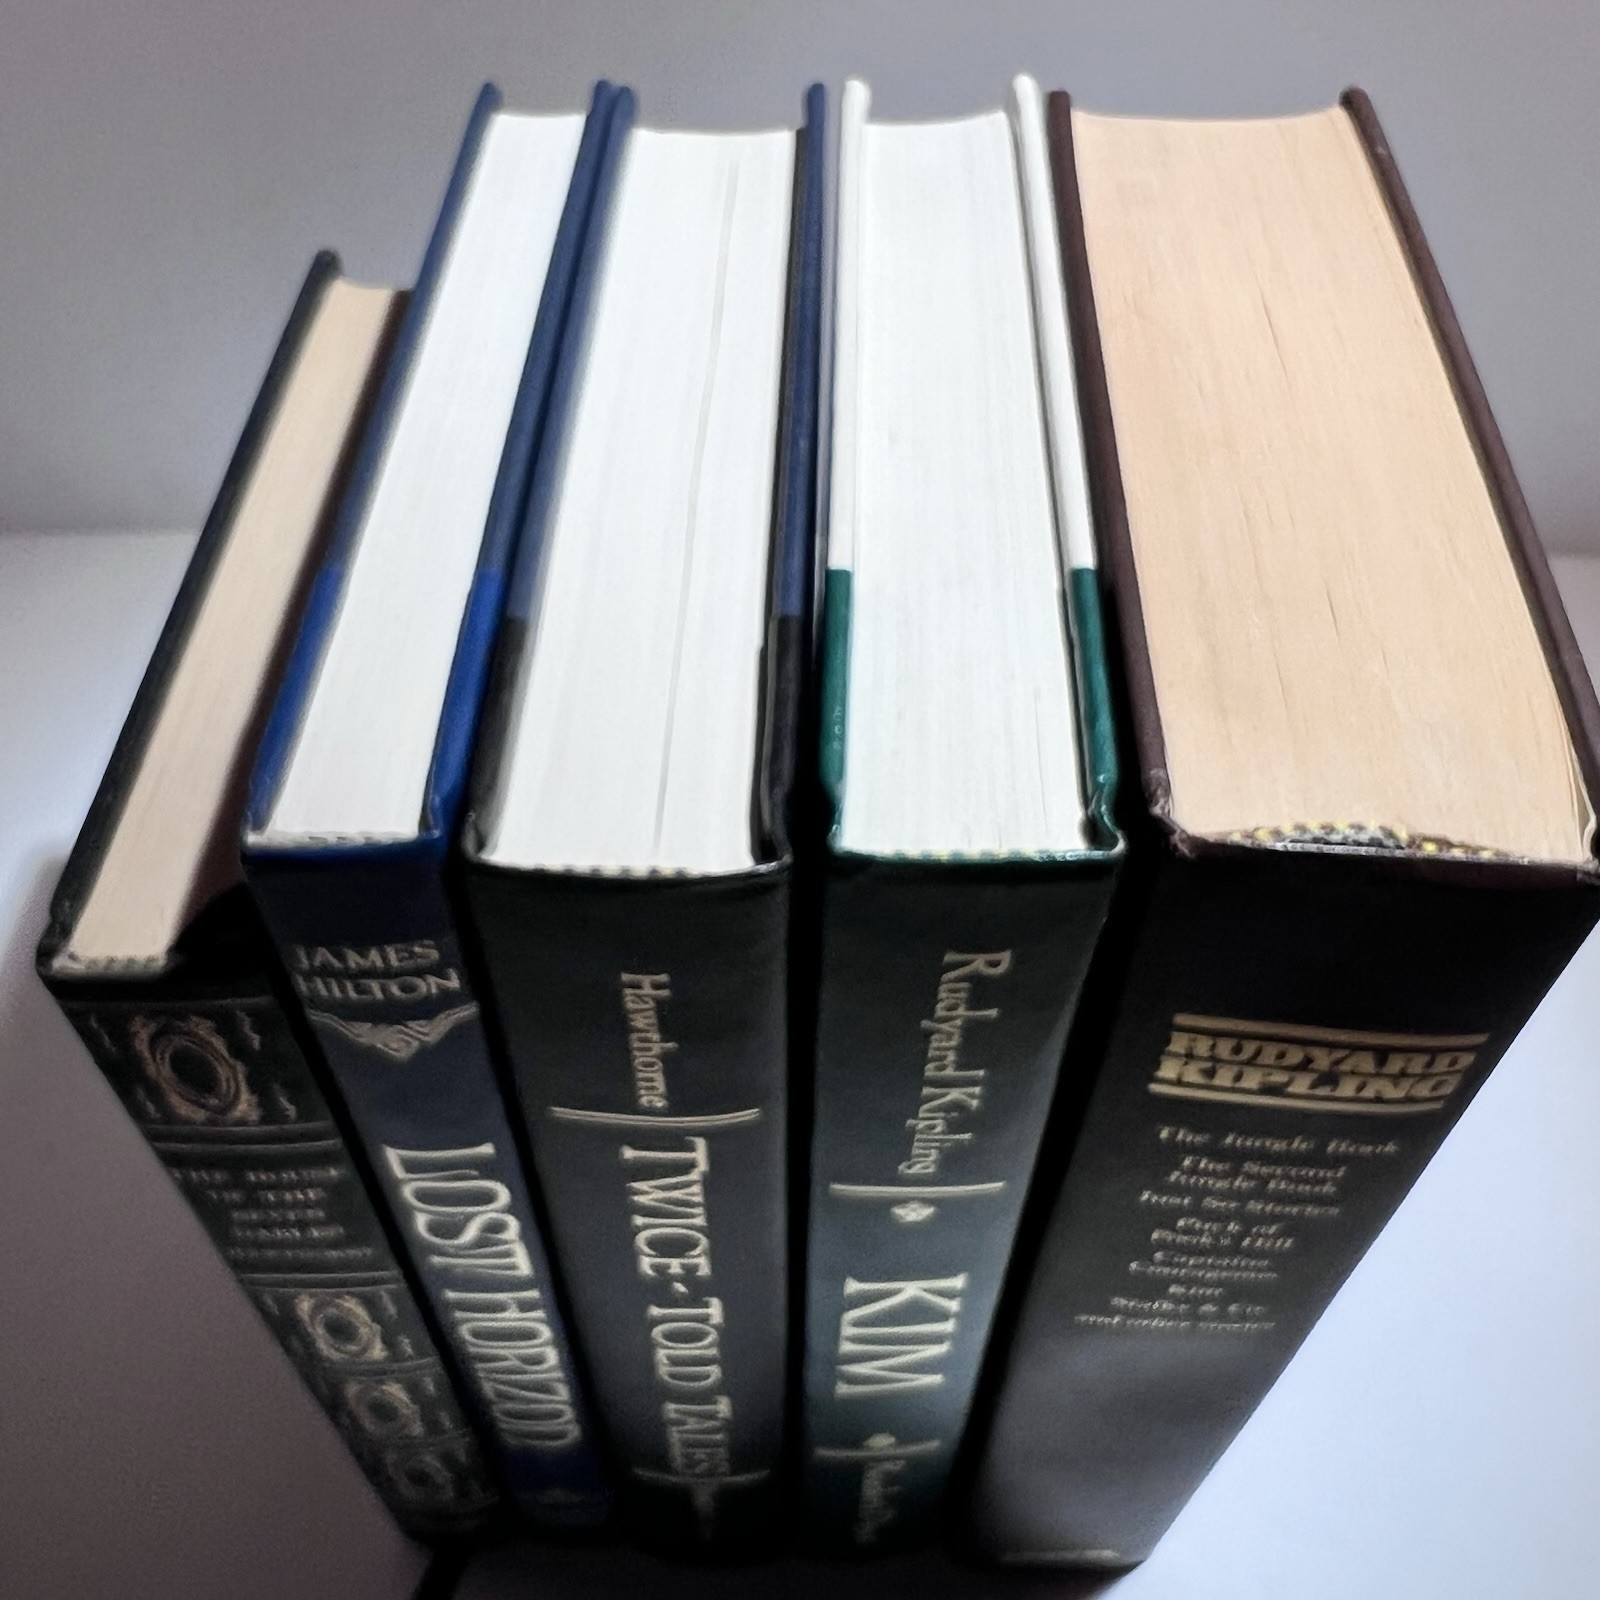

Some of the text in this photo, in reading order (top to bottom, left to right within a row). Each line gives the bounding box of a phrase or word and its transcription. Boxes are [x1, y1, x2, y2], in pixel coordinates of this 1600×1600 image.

[293, 968, 460, 1000] HILTON
[294, 940, 440, 970] JAMES
[621, 972, 680, 1107] Hawthorne
[897, 950, 1012, 1174] Rudyard Kipling
[1153, 1055, 1463, 1101] KIPLING
[1166, 1030, 1477, 1076] RUDYARD
[381, 1142, 533, 1279] LOST
[834, 1271, 968, 1401] KIM
